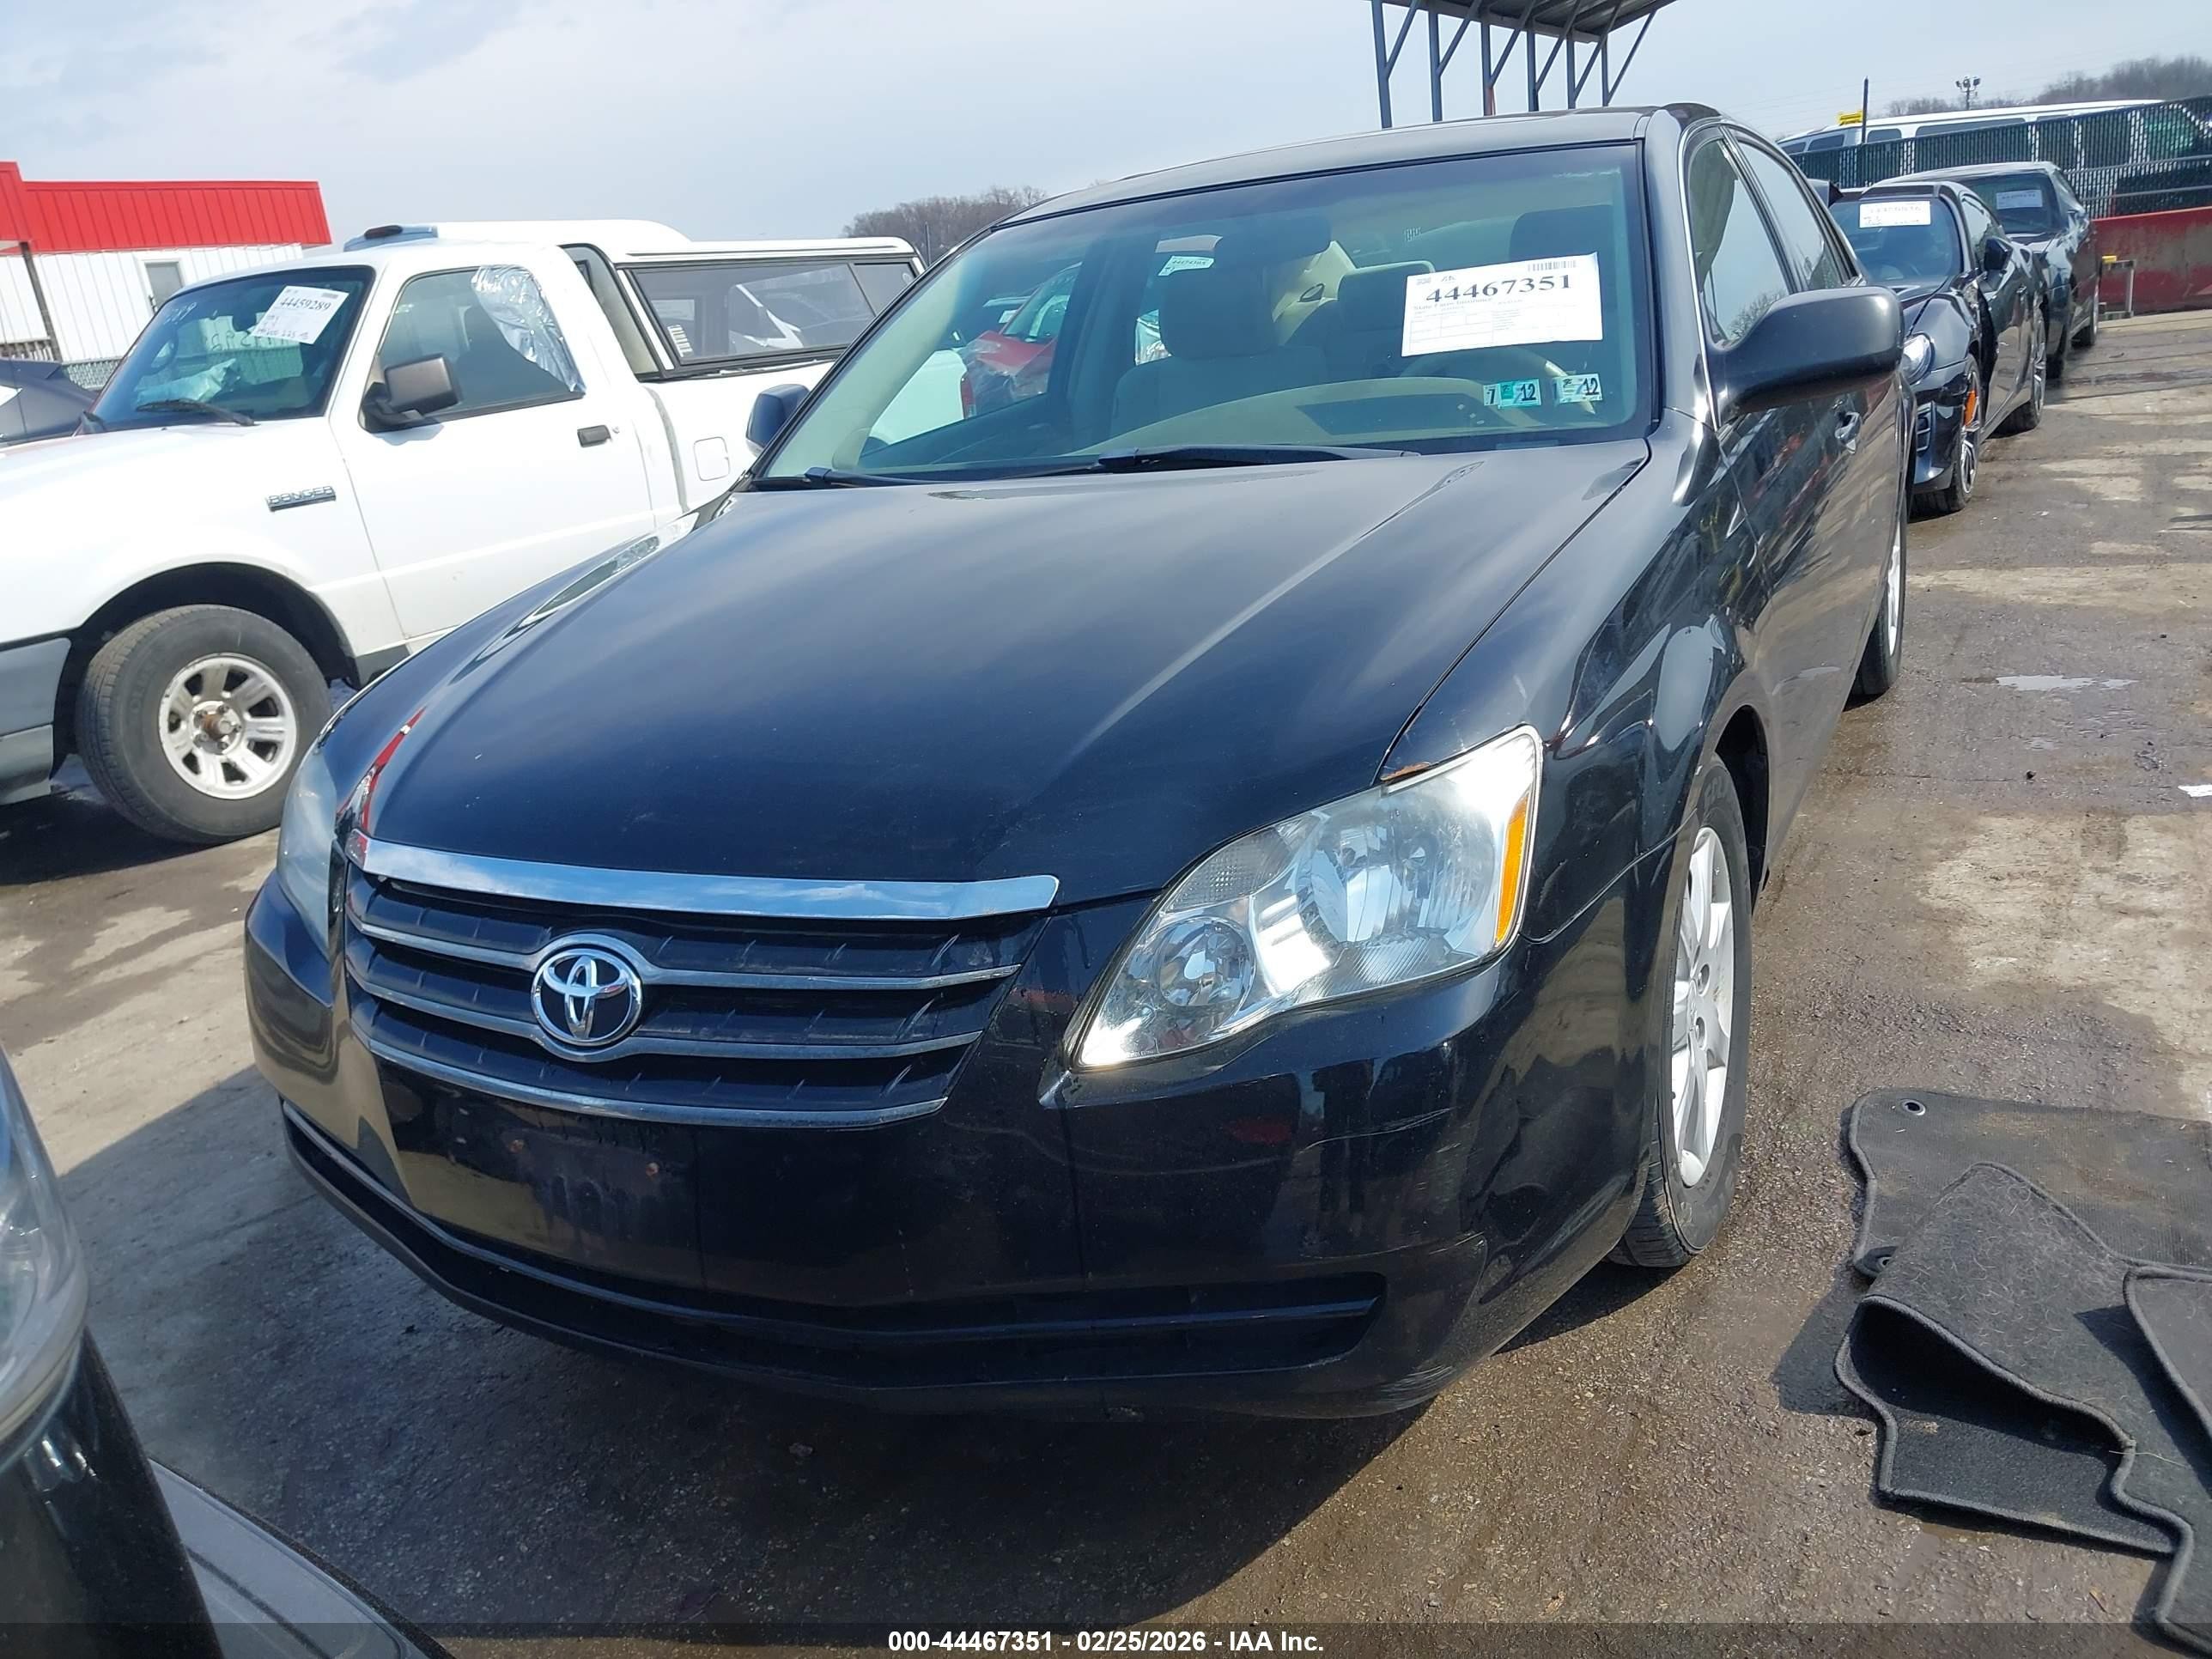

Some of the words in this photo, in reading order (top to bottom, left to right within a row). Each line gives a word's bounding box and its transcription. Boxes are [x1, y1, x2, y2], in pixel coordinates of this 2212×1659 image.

[1425, 274, 1571, 302] 44467351
[280, 297, 331, 310] 44459289
[1520, 383, 1536, 401] 12
[1583, 377, 1599, 395] 12
